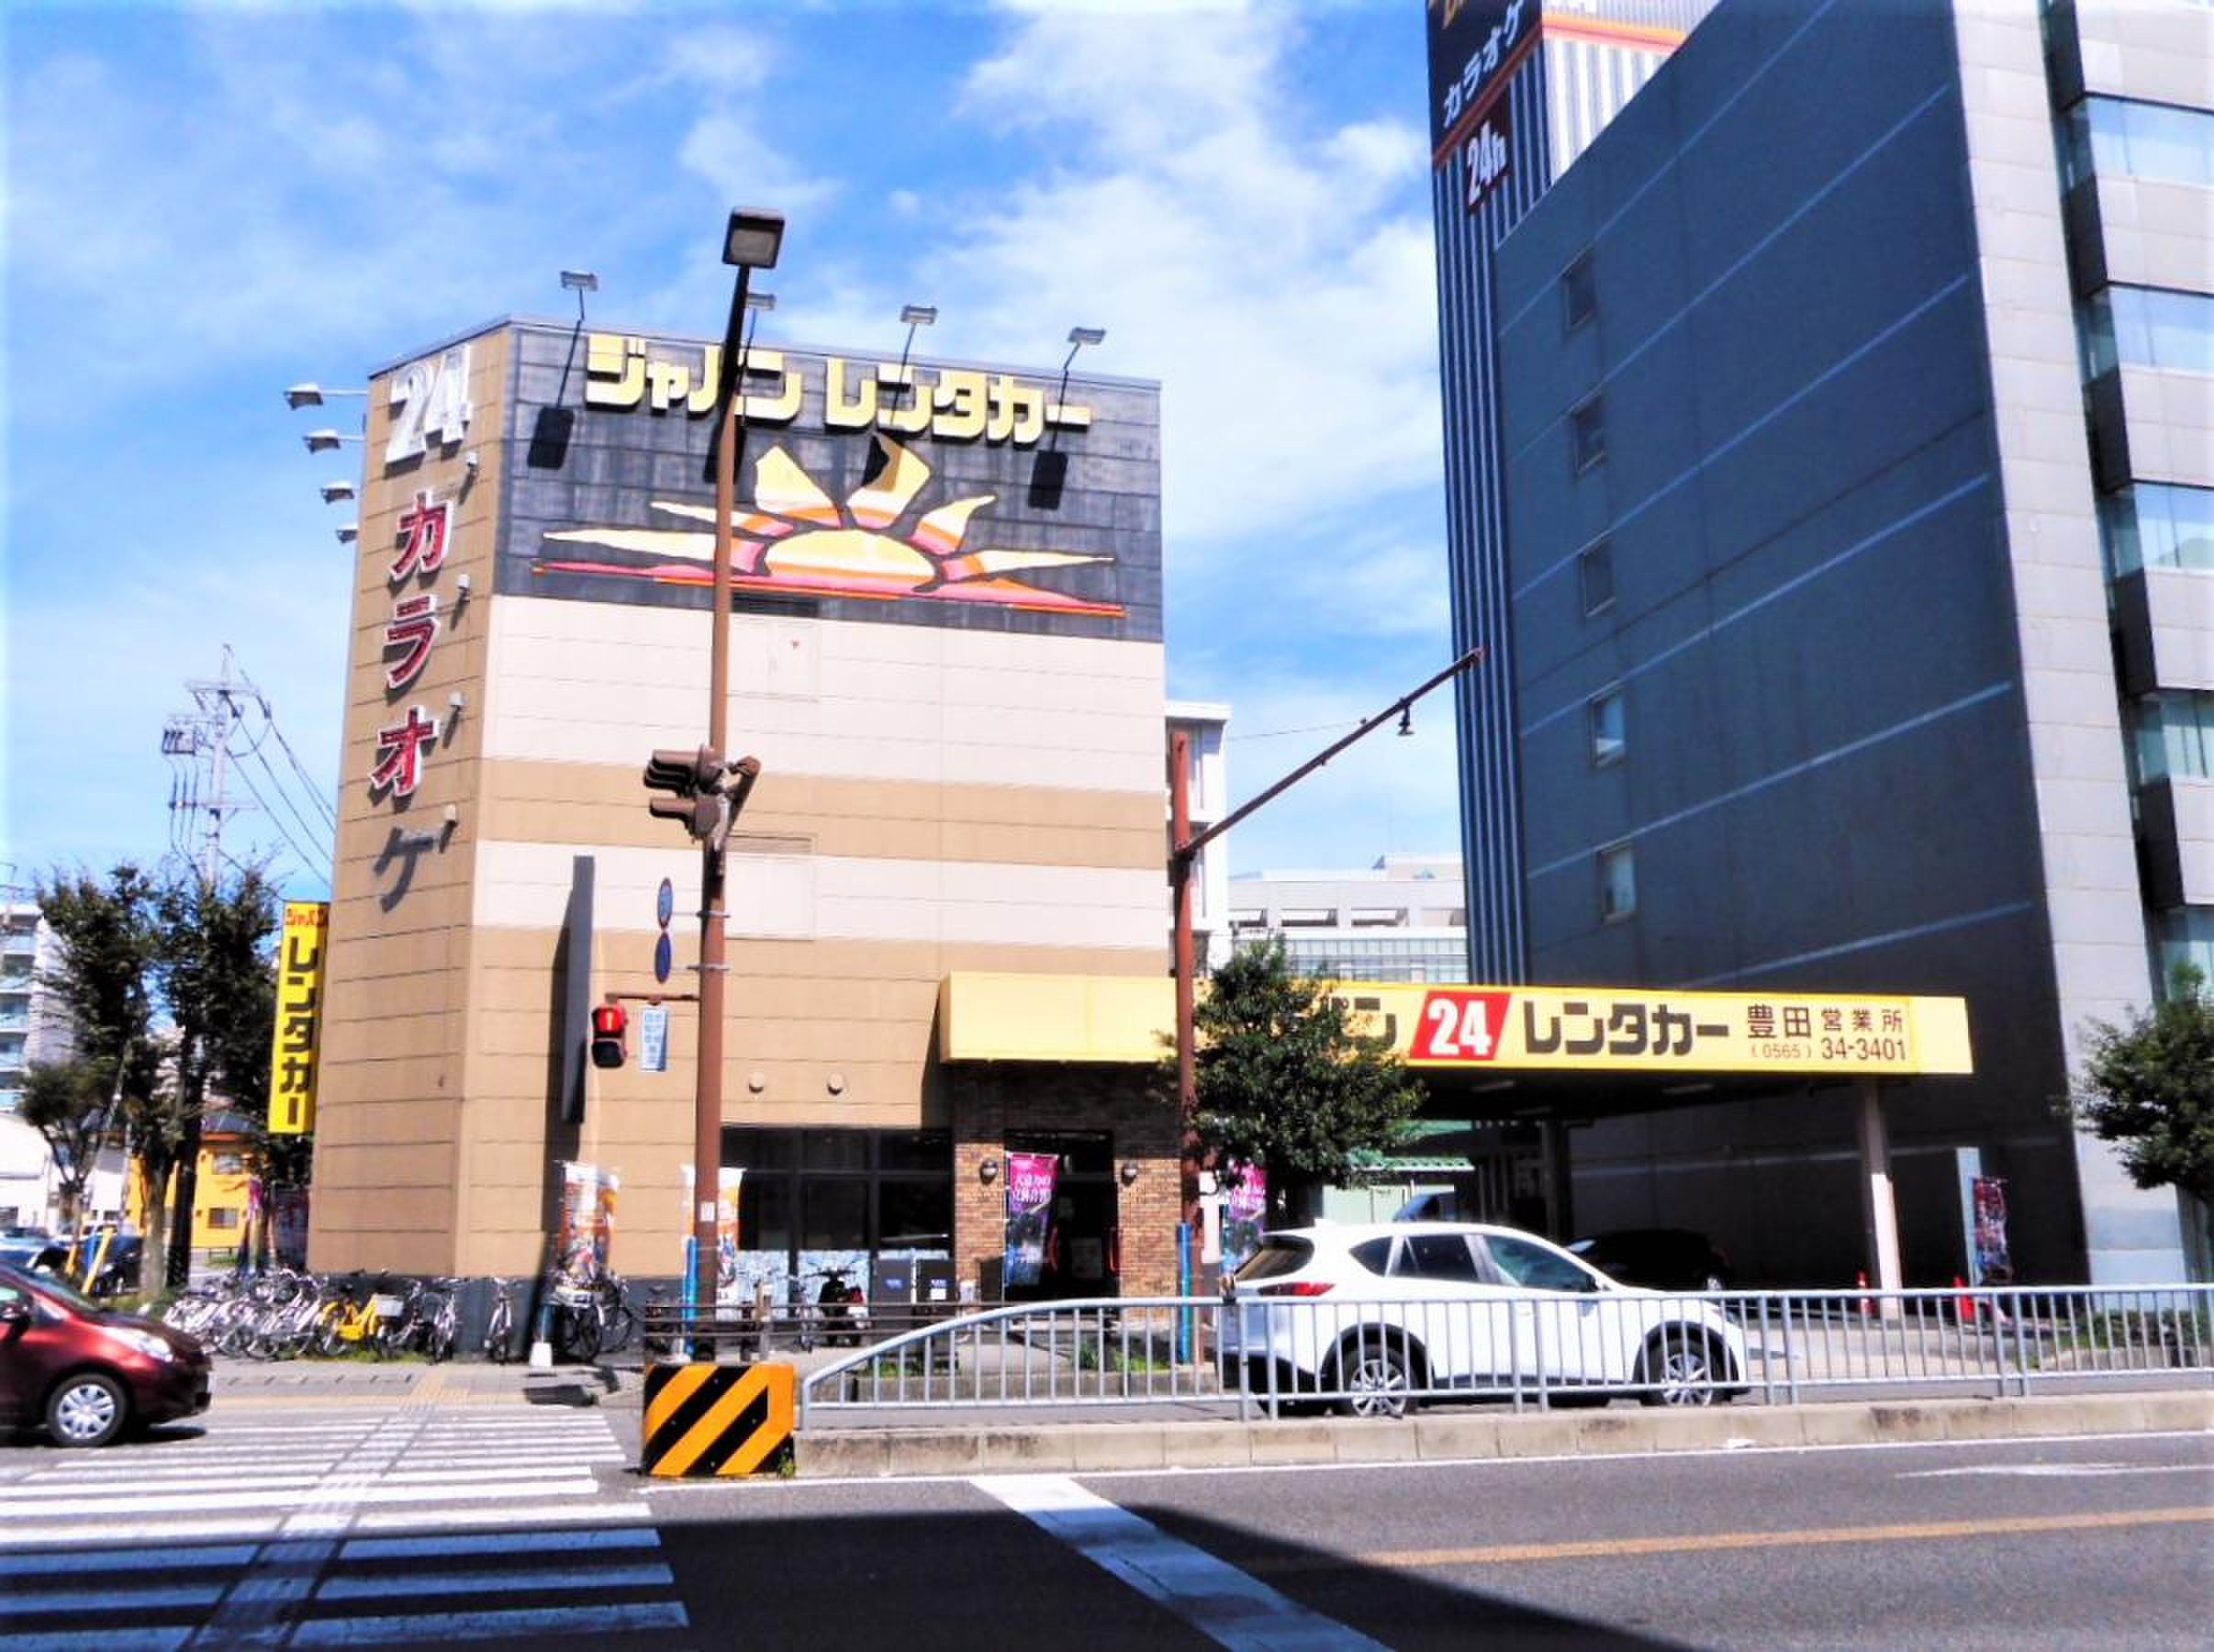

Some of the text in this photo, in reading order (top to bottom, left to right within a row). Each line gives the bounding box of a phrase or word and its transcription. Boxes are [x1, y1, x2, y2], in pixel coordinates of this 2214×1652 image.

[385, 343, 474, 460] 24
[825, 358, 1093, 444] レンタカー
[279, 936, 319, 1126] レンタカー
[1427, 998, 1493, 1056] 24
[1523, 999, 1730, 1057] レンタカー
[1747, 1003, 1904, 1040] 豊田営業所
[1750, 1036, 1906, 1062] (0565) 34-3401
